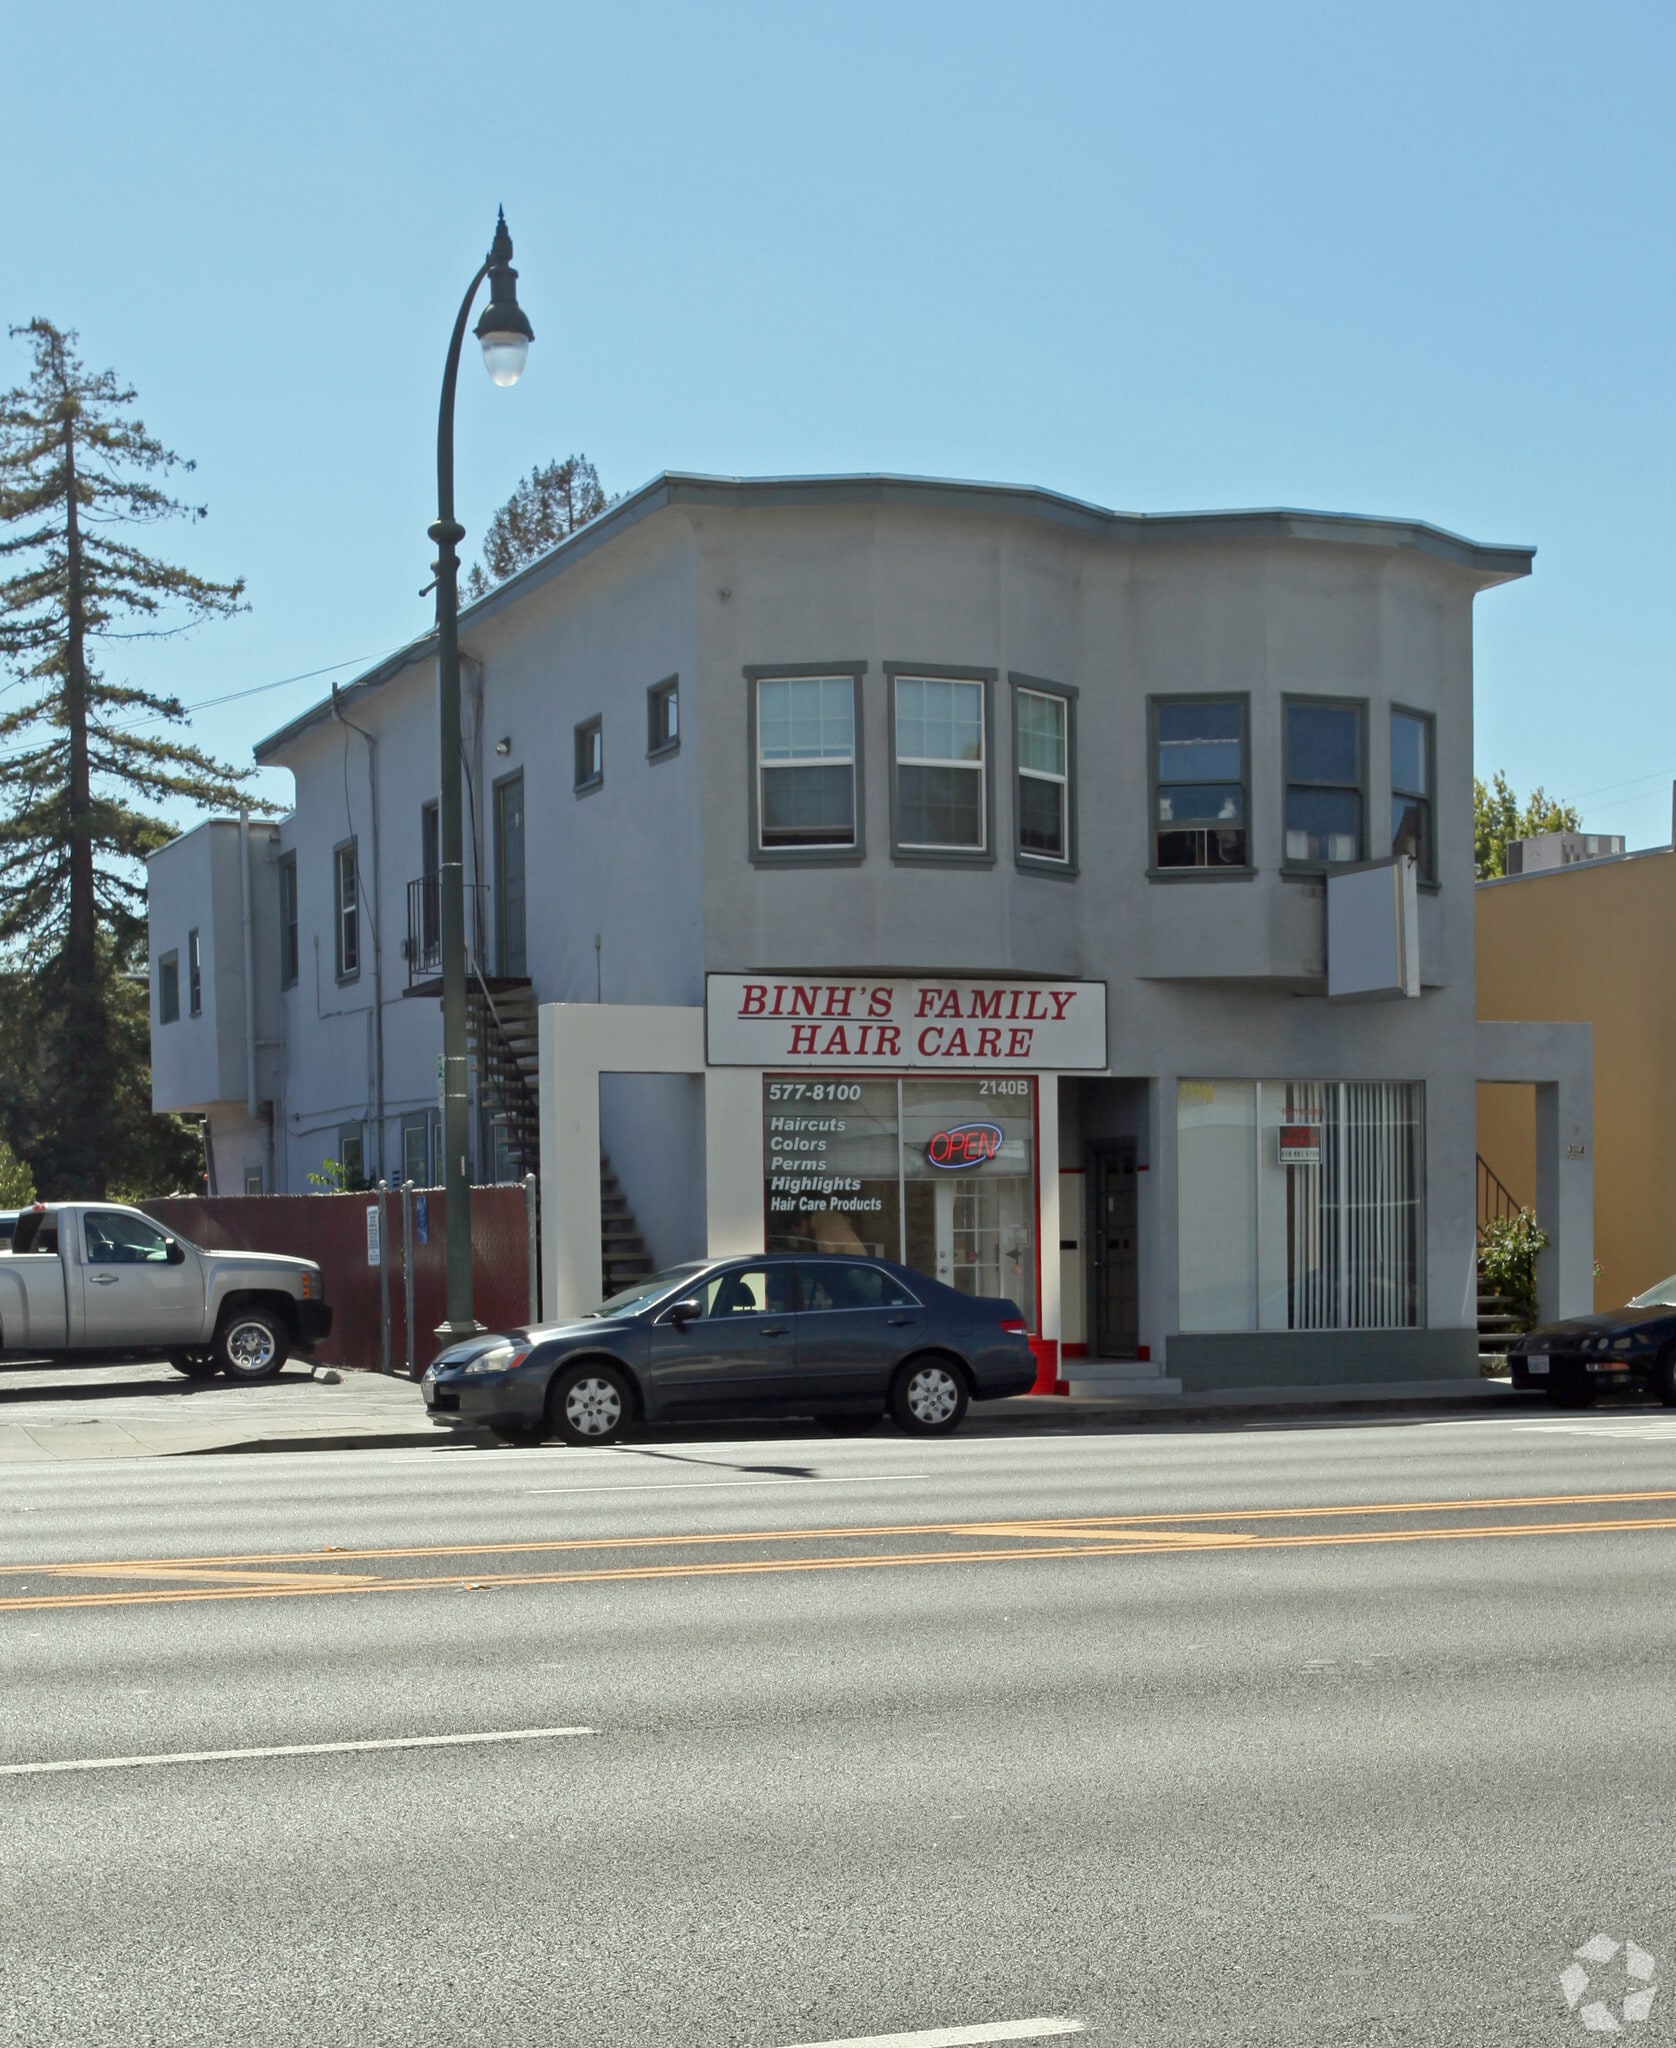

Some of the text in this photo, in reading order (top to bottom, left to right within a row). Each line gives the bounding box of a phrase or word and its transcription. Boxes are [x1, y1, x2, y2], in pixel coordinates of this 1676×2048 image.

[738, 984, 1077, 1020] BINH'S FAMILY
[786, 1024, 1034, 1058] HAIR CARE
[768, 1084, 862, 1100] 577-8100
[979, 1080, 1029, 1095] 2140B
[770, 1116, 847, 1131] Haircuts
[770, 1136, 827, 1151] Colors
[929, 1131, 998, 1161] OPEN
[770, 1156, 828, 1171] Perms
[770, 1176, 862, 1194] Highlights
[770, 1196, 882, 1211] Hair Care Products
